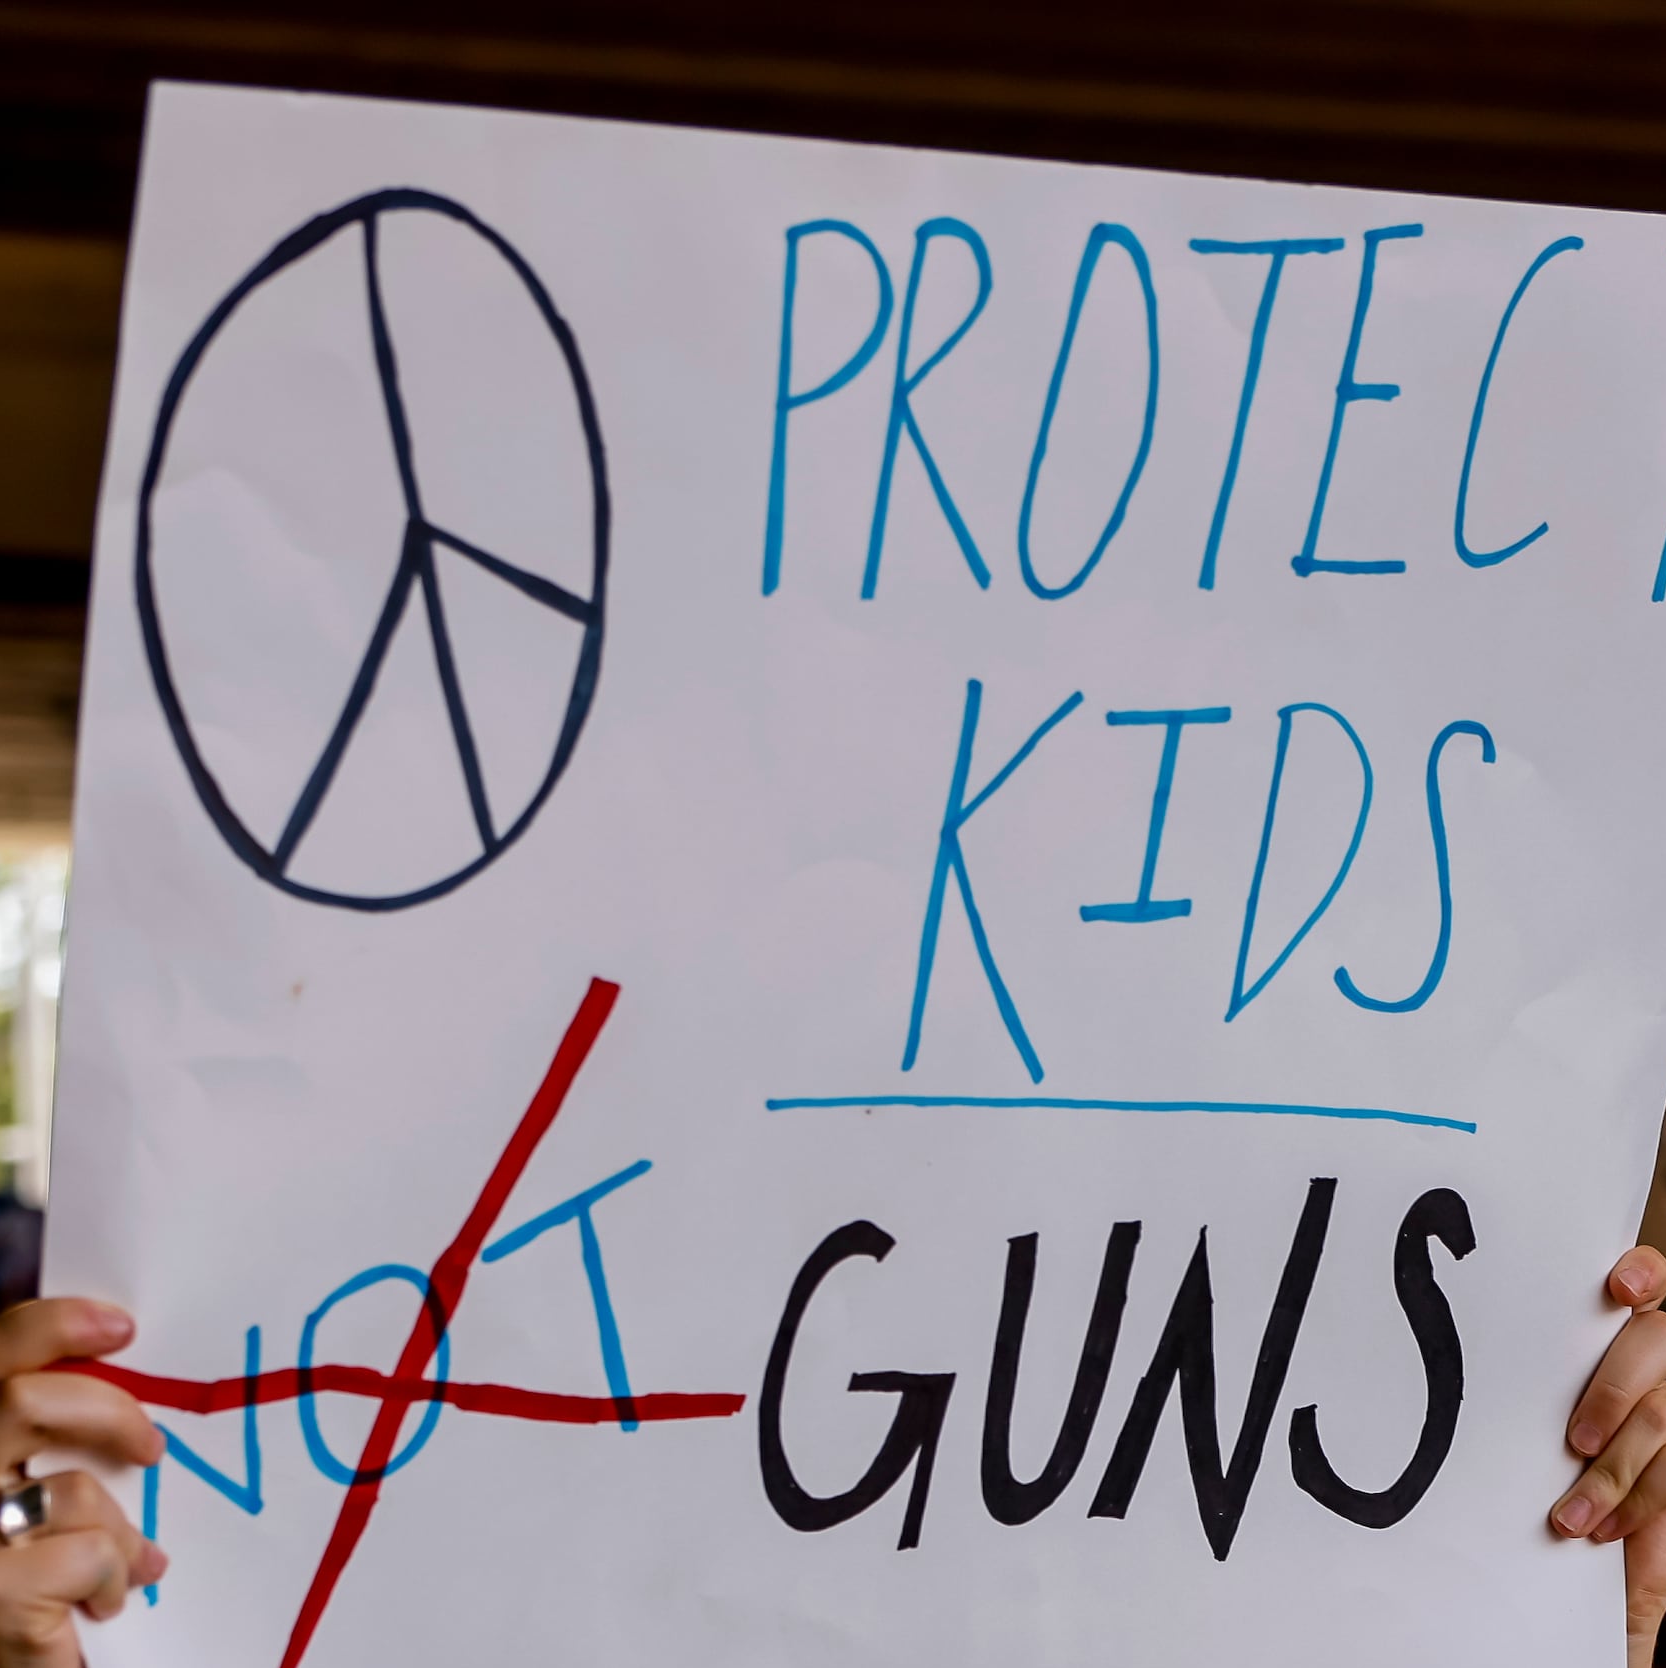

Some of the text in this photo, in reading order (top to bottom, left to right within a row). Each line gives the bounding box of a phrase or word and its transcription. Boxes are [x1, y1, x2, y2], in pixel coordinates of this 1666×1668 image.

[900, 678, 1496, 1085] KIDS
[142, 1159, 1478, 1607] NOT GUNS
